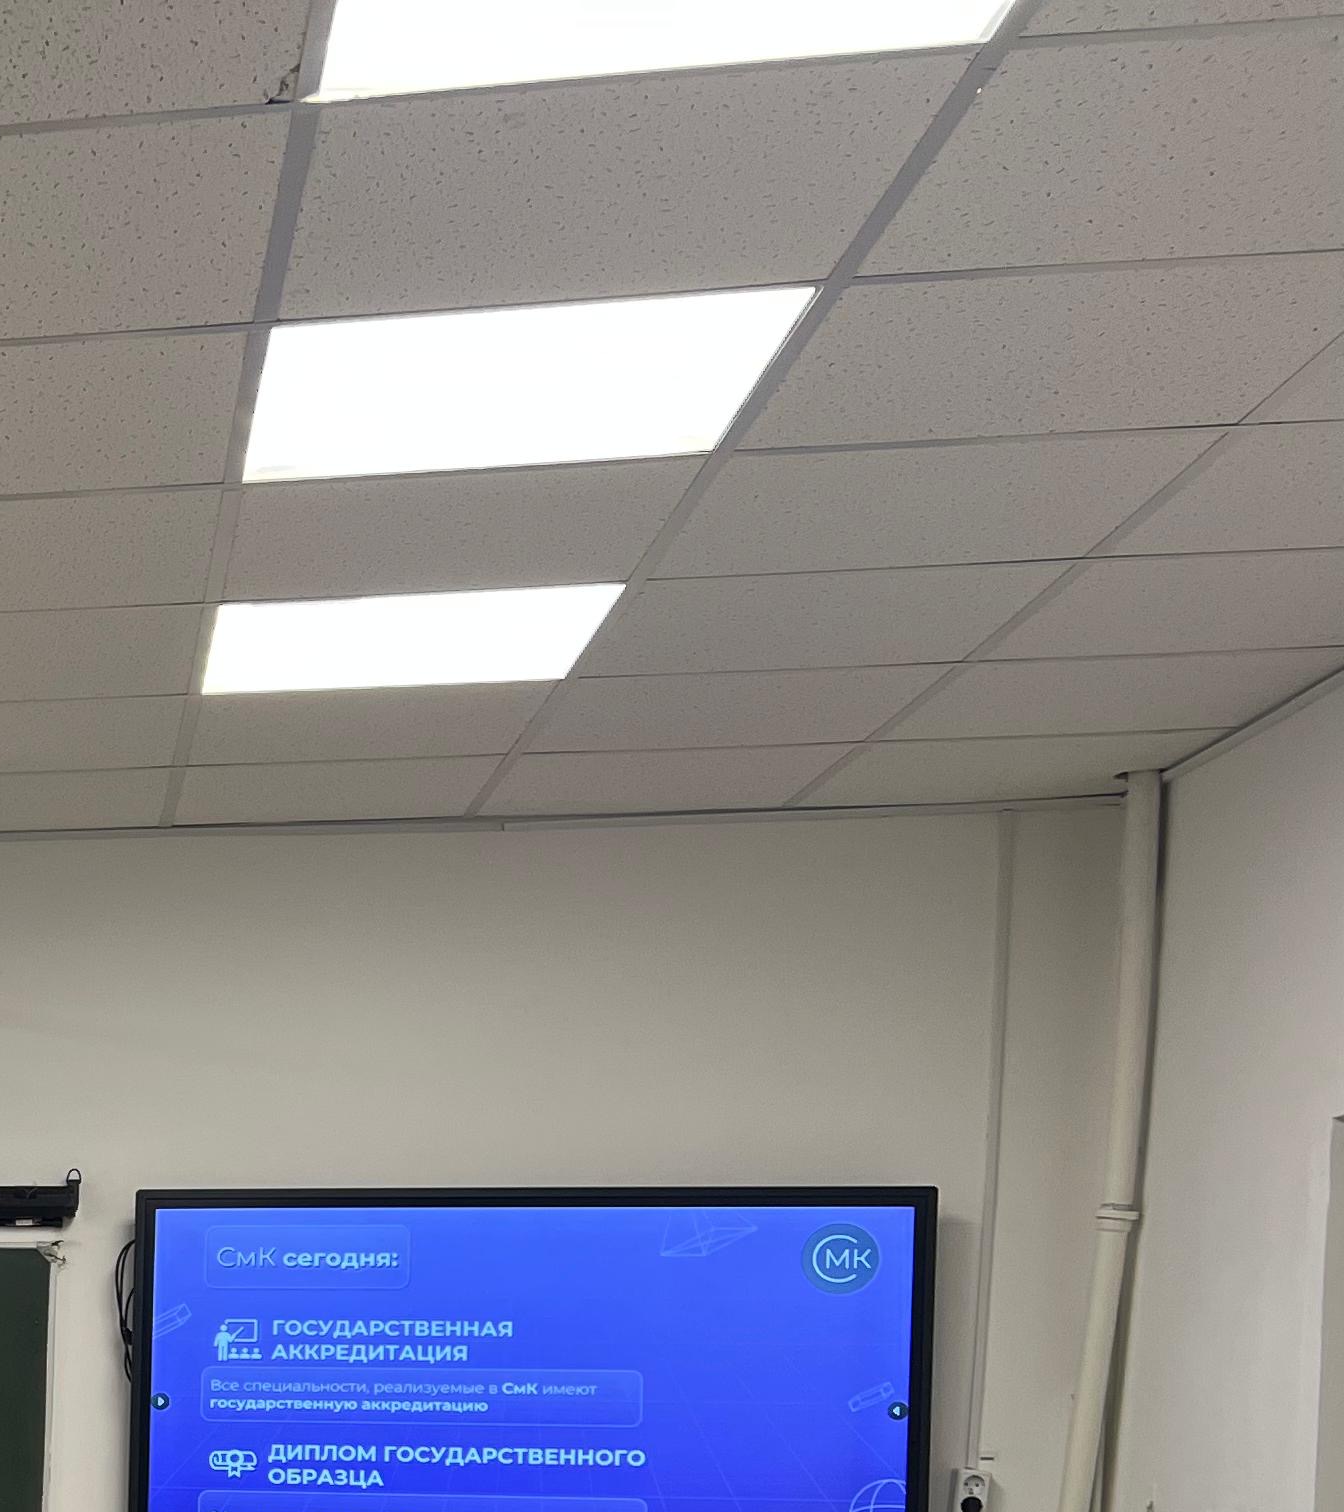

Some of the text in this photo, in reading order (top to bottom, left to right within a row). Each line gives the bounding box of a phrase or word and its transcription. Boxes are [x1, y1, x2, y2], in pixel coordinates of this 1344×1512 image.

[216, 1246, 400, 1270] СмК сегодня:
[272, 1319, 513, 1339] ГОСУДАРСТВЕННАЯ
[271, 1344, 469, 1364] АККРЕДИТАЦИЯ
[210, 1379, 598, 1399] Все специальности, реализуемые в СмК имеют
[209, 1397, 489, 1415] государственную аккредитацию
[267, 1443, 647, 1468] ДИПЛОМ ГОСУДАРСТВЕННОГО
[267, 1468, 385, 1489] ОБРАЗЦА
